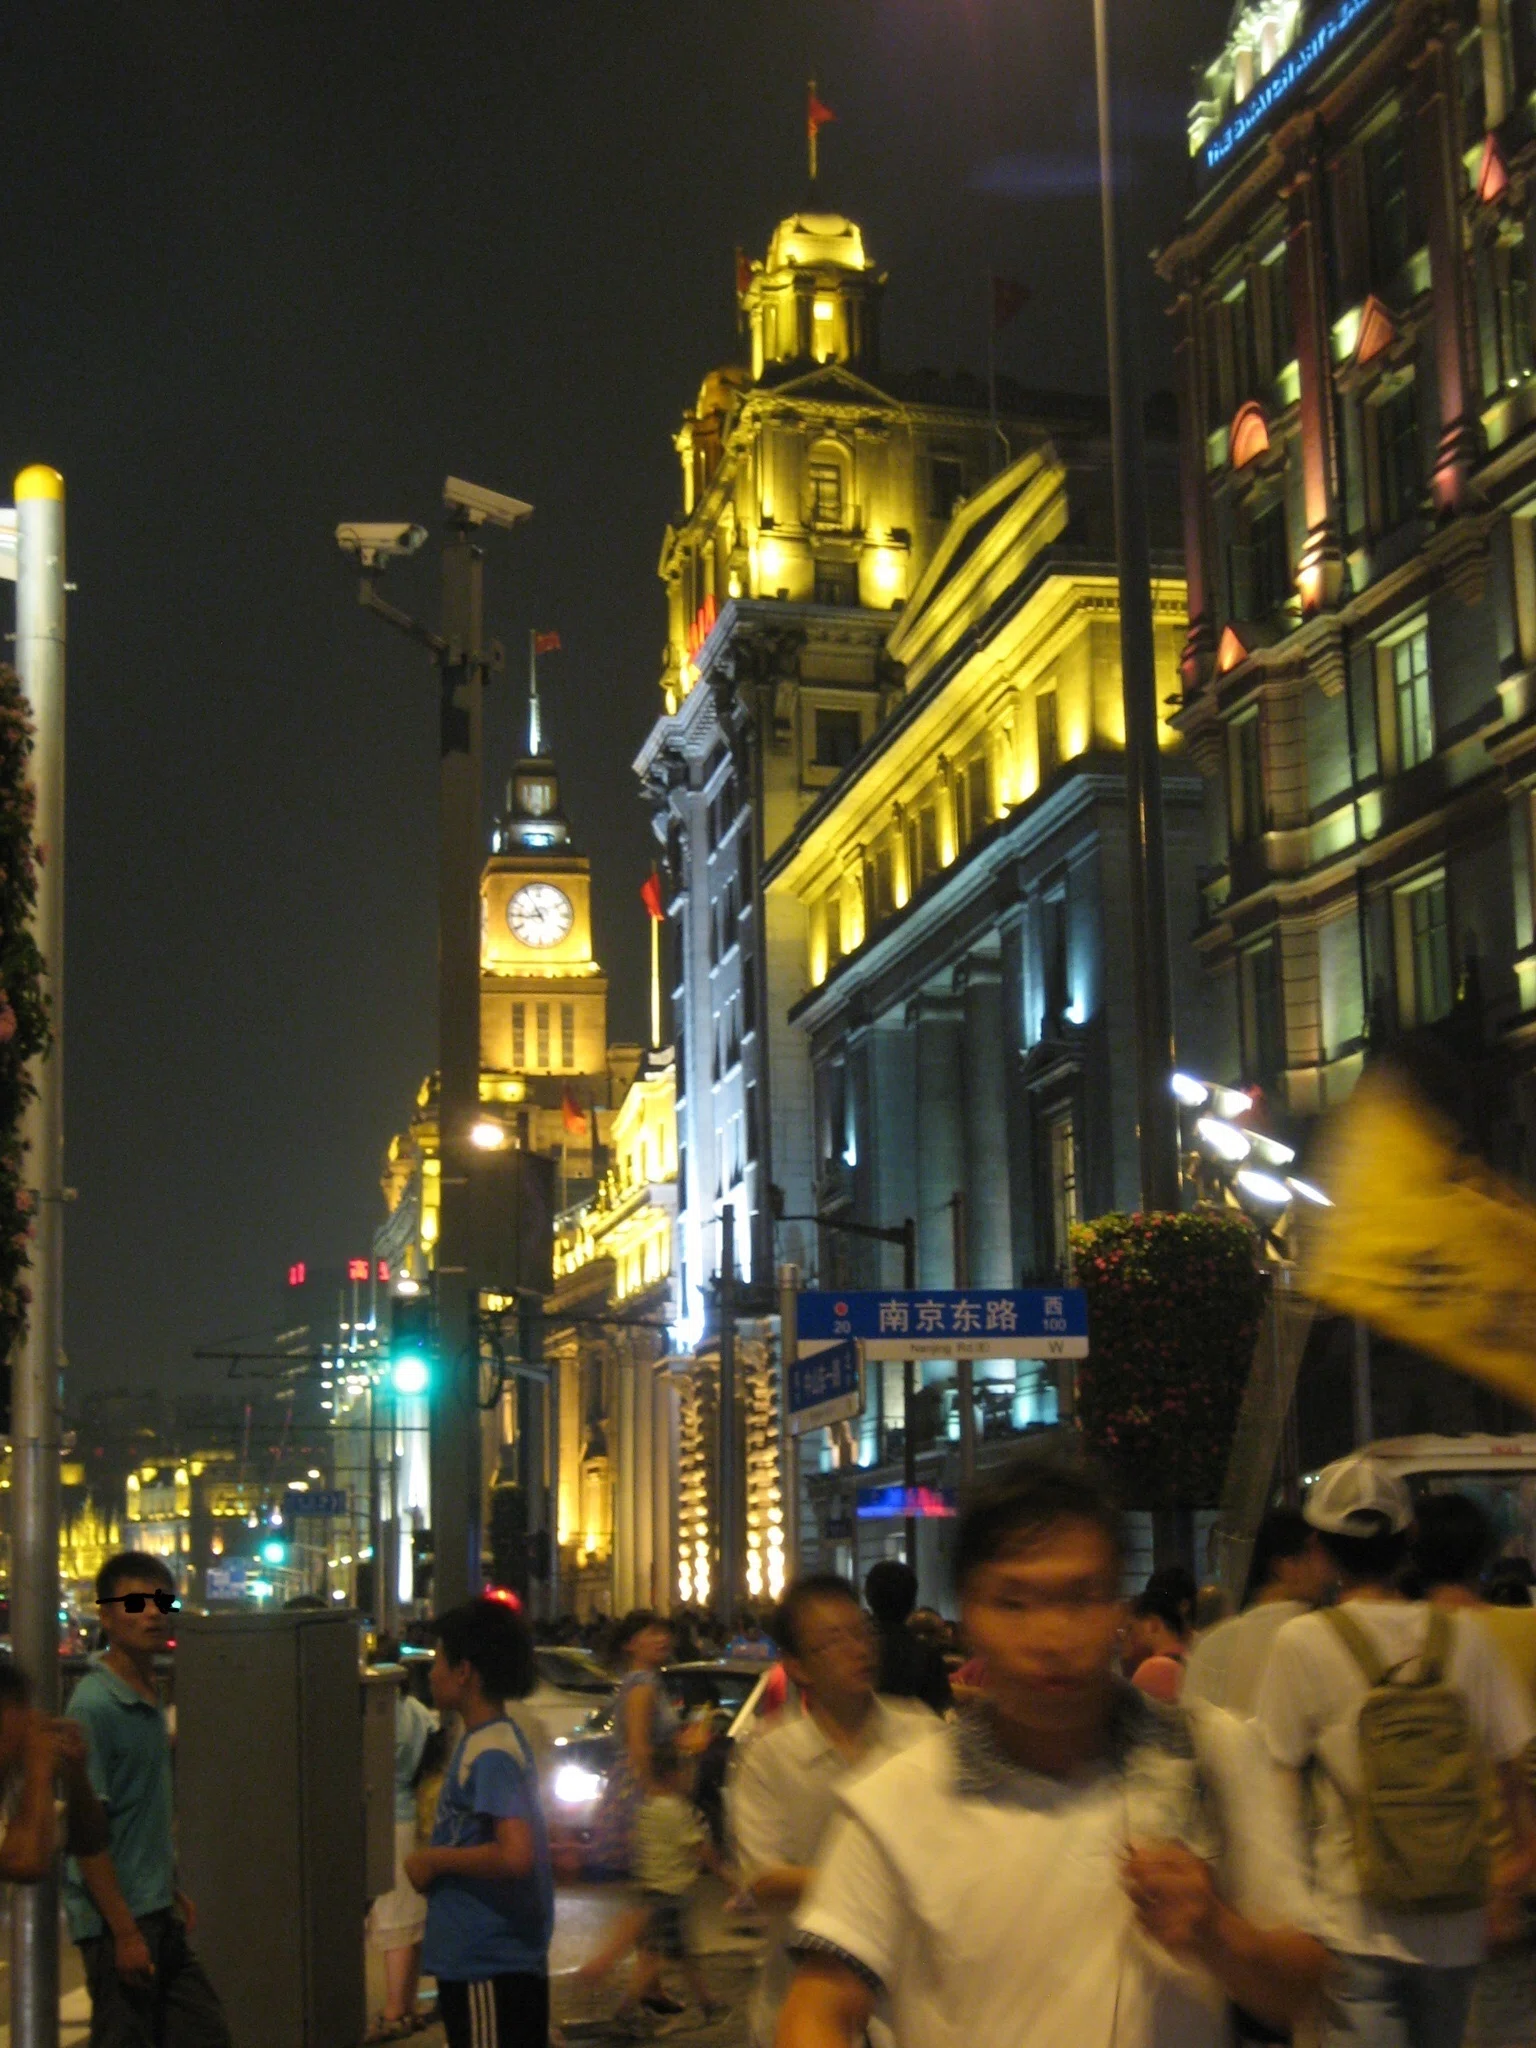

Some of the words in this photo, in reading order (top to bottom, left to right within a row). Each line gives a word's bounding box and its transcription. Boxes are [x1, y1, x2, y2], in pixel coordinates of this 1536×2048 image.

[879, 1298, 1018, 1333] 南京东路
[833, 1320, 851, 1334] 20
[1043, 1318, 1067, 1332] 100
[1047, 1340, 1064, 1353] W
